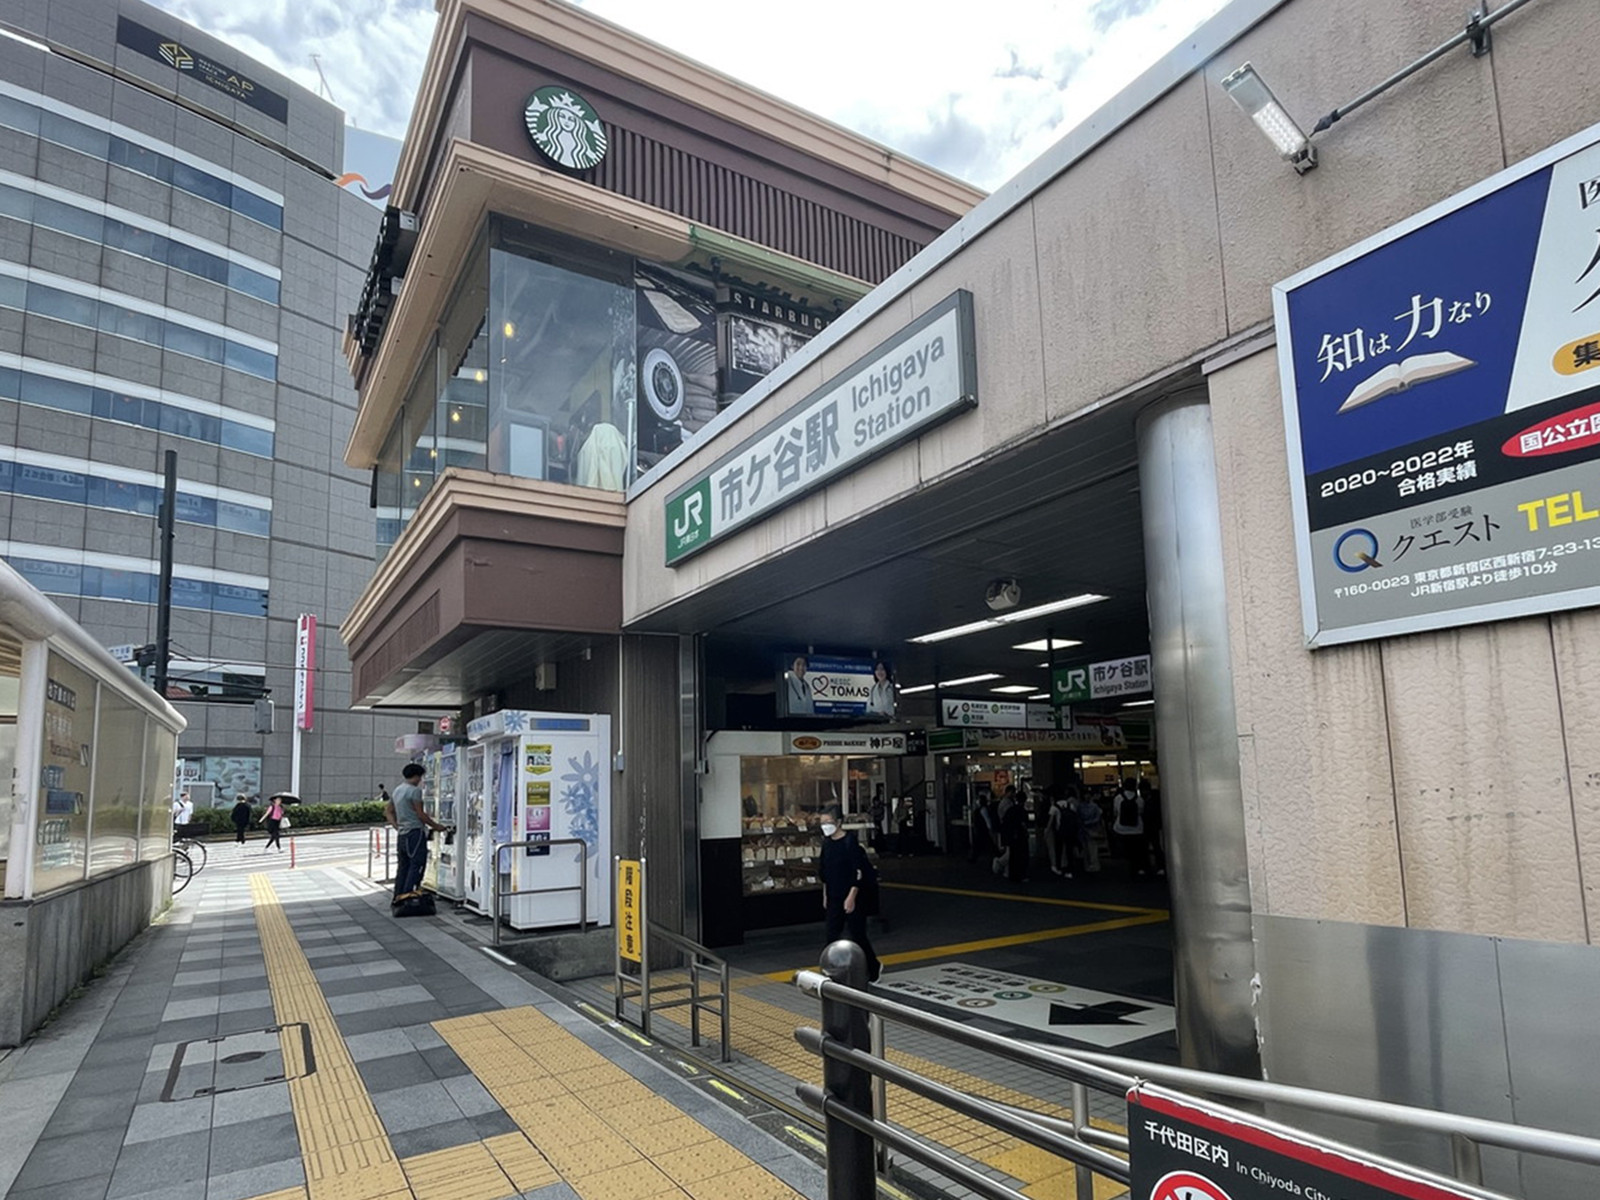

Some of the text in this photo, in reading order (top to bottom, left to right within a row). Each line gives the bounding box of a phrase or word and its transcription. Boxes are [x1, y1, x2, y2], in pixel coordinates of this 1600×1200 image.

[227, 75, 254, 91] AP
[734, 292, 830, 330] STARBUC
[1317, 291, 1491, 384] 知は力なり
[852, 335, 945, 412] Ichigaya
[853, 386, 931, 447] Station
[1397, 460, 1478, 498] 合格実績
[674, 490, 703, 537] JR
[1410, 505, 1473, 529] 医学部受験
[1517, 490, 1600, 532] TEL
[1392, 514, 1500, 562] クエスト
[1410, 560, 1558, 598] JR新宿駅より徒歩10分
[830, 686, 869, 698] TOMAS
[1057, 669, 1087, 692] JR
[1093, 683, 1123, 695] Ichigaya
[1123, 679, 1149, 690] Station
[1144, 1120, 1230, 1168] 千代田区内
[1236, 1161, 1248, 1175] In
[1251, 1166, 1302, 1196] Chiyoda
